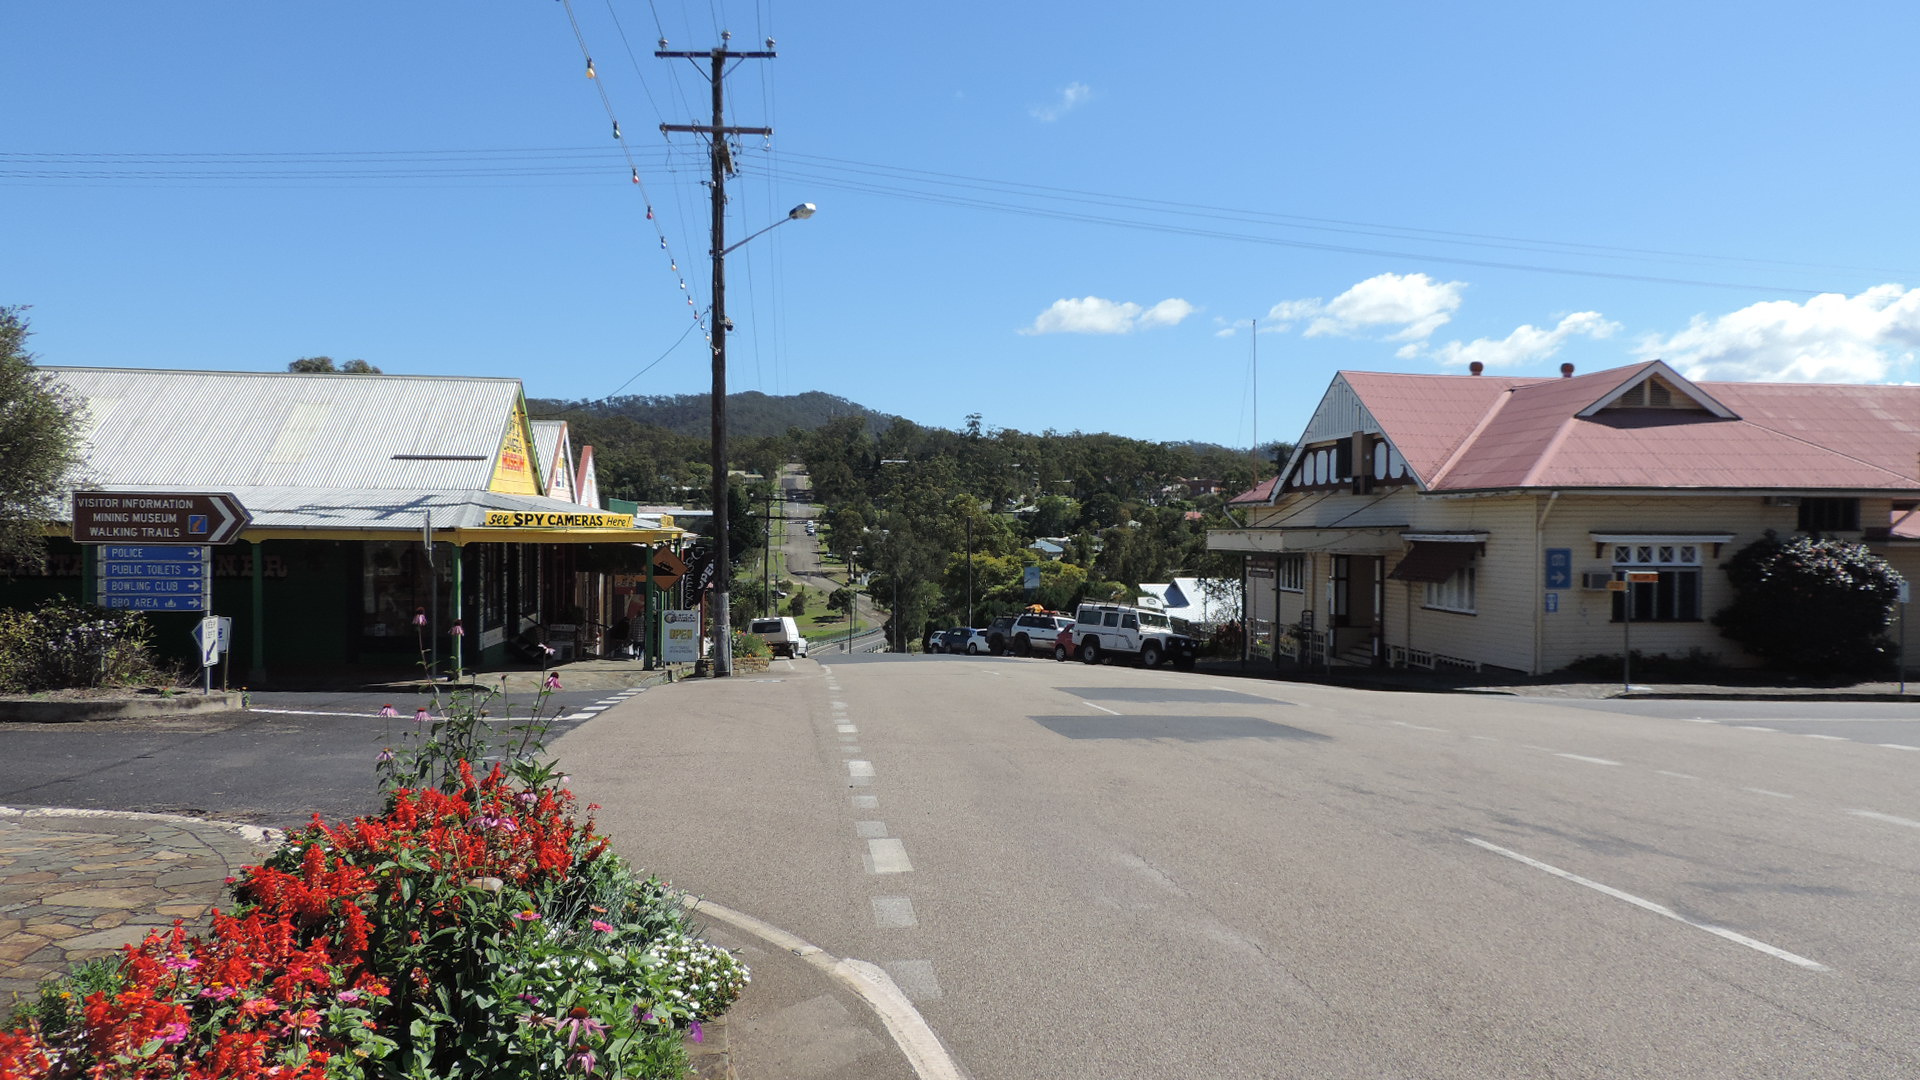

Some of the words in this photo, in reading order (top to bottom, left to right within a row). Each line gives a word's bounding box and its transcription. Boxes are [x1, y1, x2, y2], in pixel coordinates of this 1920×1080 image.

[77, 498, 119, 508] VISITOR
[122, 499, 193, 509] INFORMATION
[93, 512, 129, 522] MINING
[132, 513, 177, 523] MUSEUM
[489, 513, 508, 525] see
[513, 512, 545, 526] SPY
[547, 514, 603, 526] CAMERAS
[606, 516, 631, 527] Here!
[89, 526, 138, 537] WALKING
[141, 527, 180, 538] TRAILS
[111, 548, 144, 558] POLICE
[111, 564, 142, 574] PUBLIC
[147, 565, 181, 575] TOILETS
[111, 581, 151, 591] BOWLING
[154, 581, 179, 591] CLUB
[111, 598, 130, 608] BBQ
[134, 598, 159, 607] AREA
